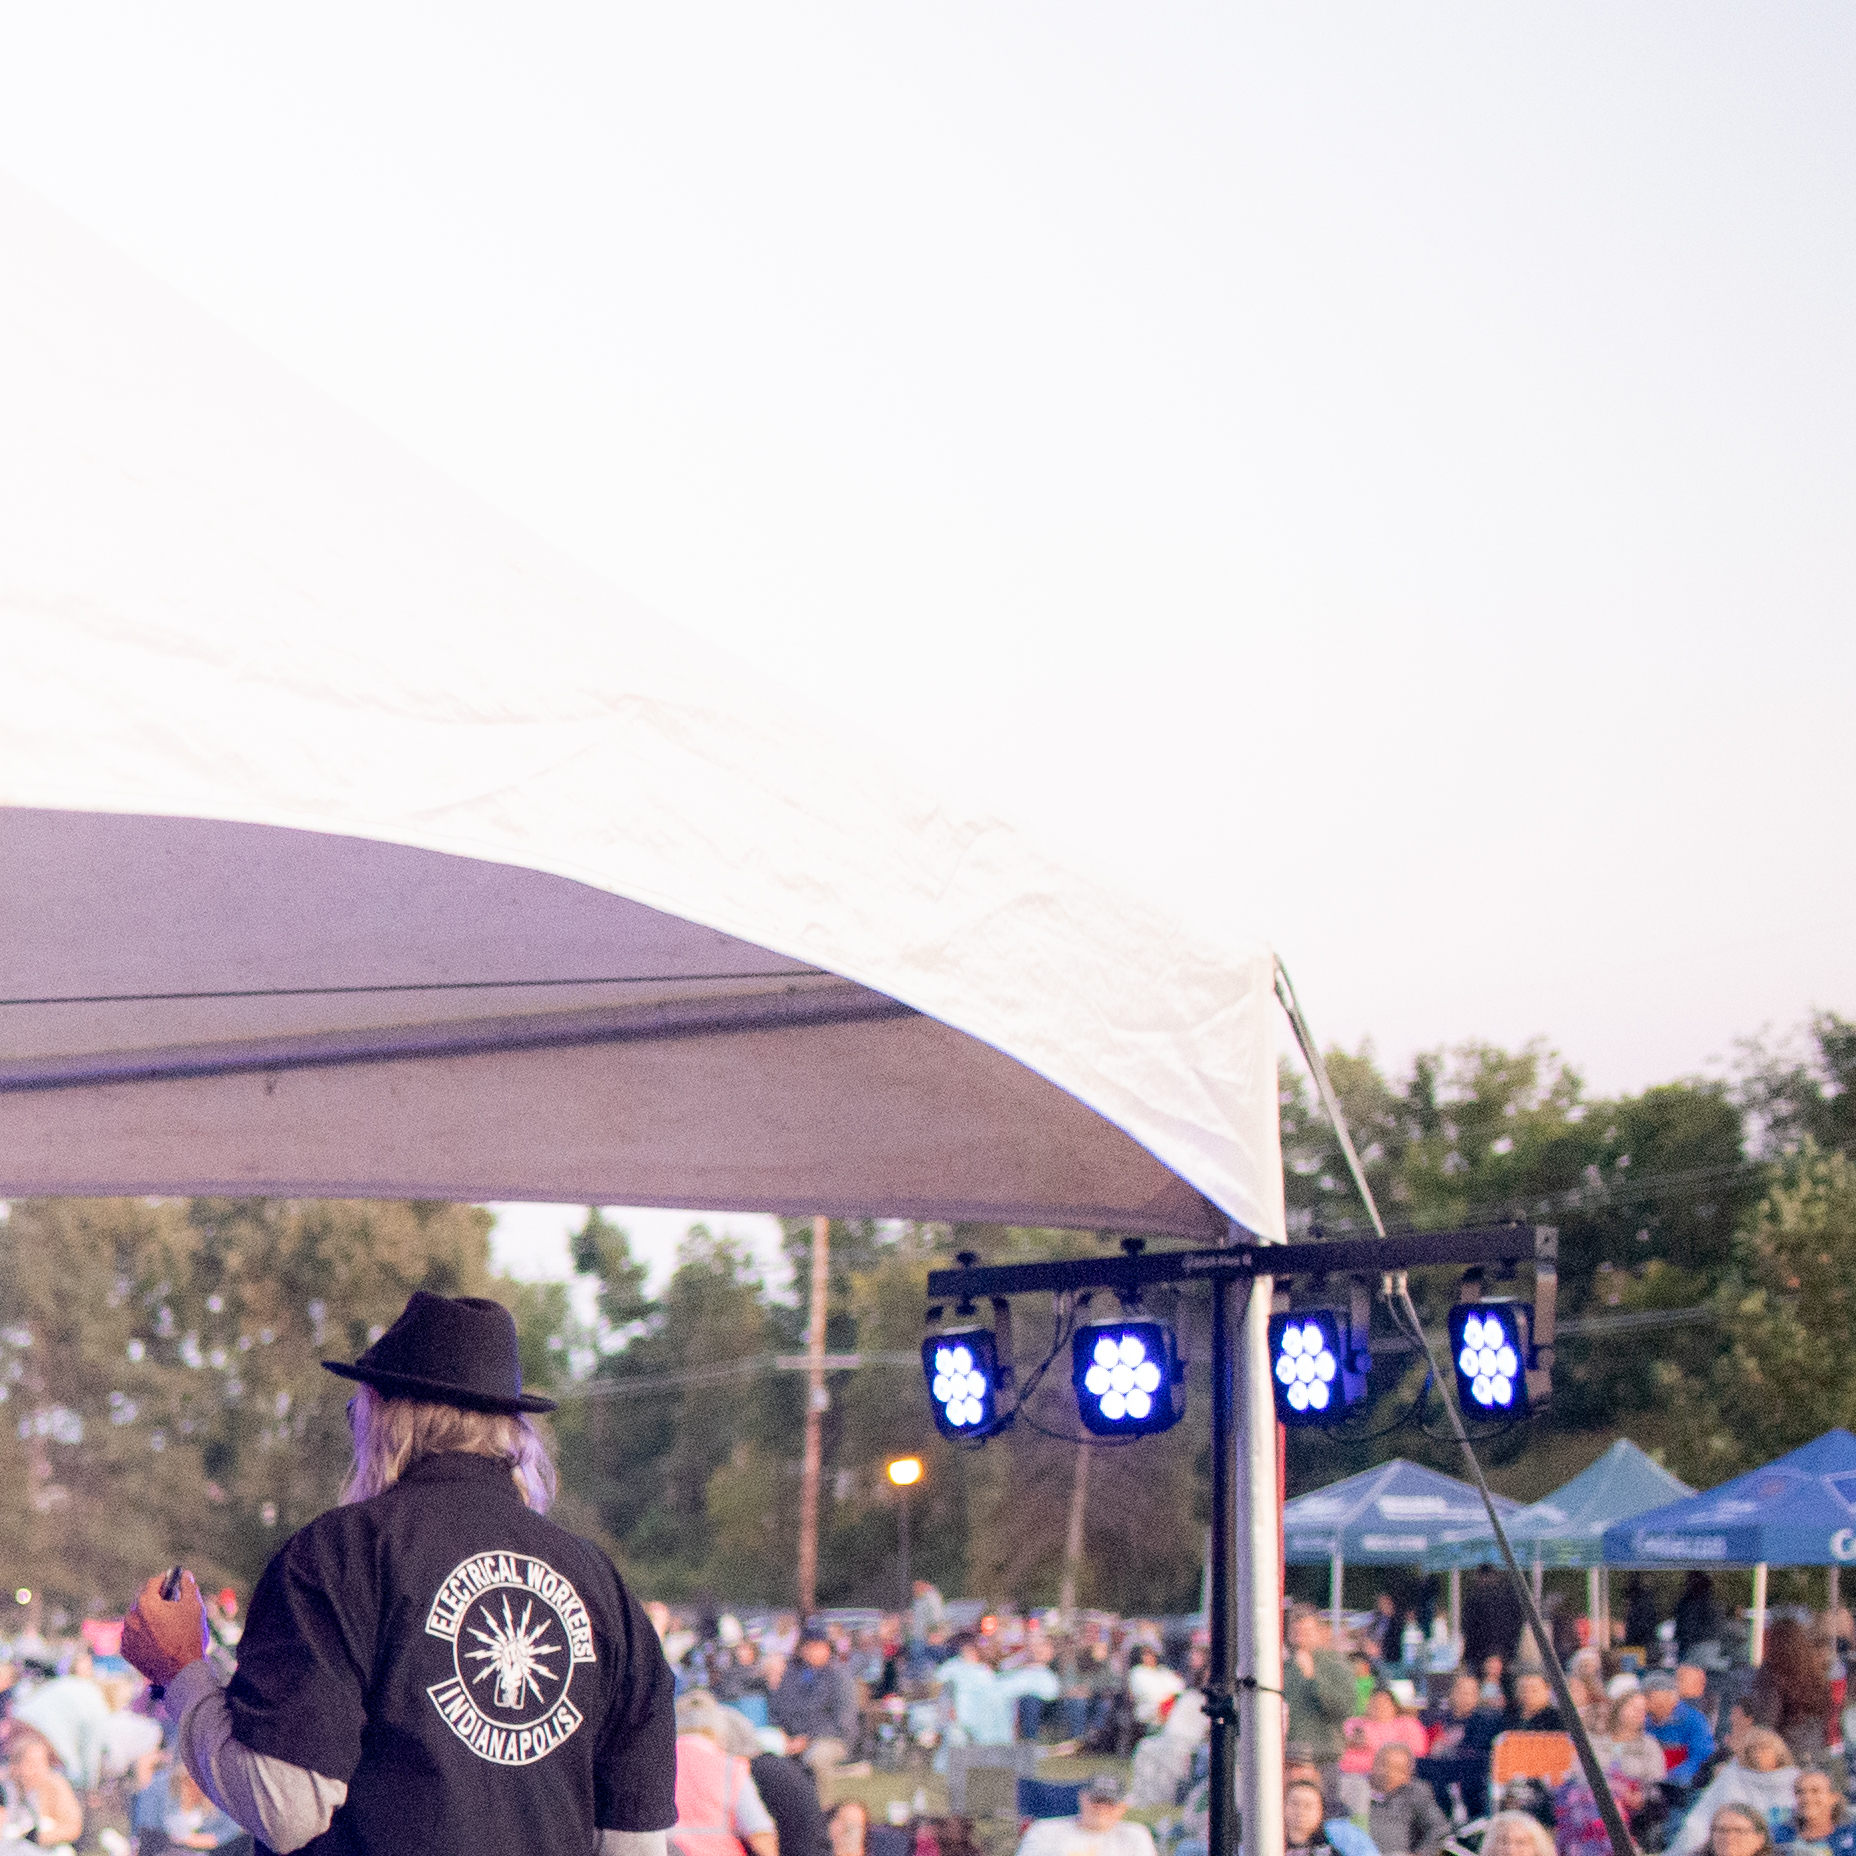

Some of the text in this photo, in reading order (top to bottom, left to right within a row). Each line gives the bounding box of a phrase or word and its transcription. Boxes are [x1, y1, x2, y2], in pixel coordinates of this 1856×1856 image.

[430, 1555, 590, 1657] ELECTRICAL WORKERS
[438, 1686, 575, 1761] INDIANAPOLIS
